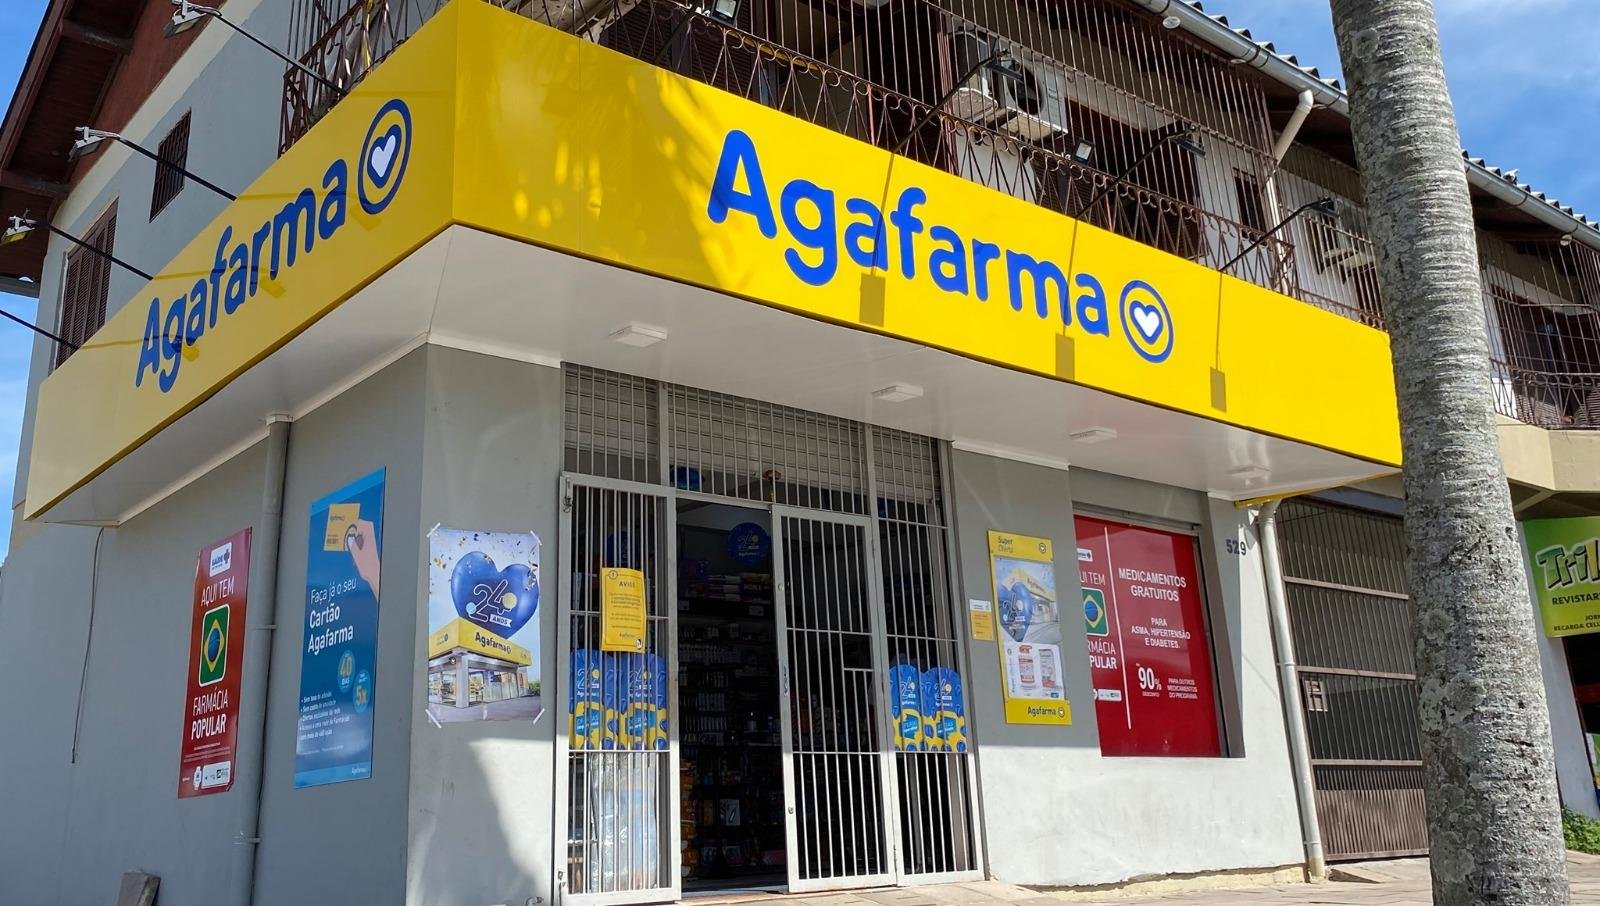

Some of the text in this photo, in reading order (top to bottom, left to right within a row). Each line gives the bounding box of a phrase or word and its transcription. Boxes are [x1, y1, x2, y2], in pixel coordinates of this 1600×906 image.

[707, 129, 1110, 337] Agafarma
[136, 159, 348, 393] Agafarma
[1226, 539, 1246, 556] 529
[1089, 572, 1106, 586] TEM
[1118, 567, 1187, 588] MEDICAMENTOS
[201, 576, 235, 607] AQUI TEM
[311, 578, 358, 605] Faça já o seu
[1130, 585, 1180, 602] GRATUITOS
[1552, 592, 1600, 606] REVISTAR
[466, 579, 515, 622] 24
[309, 603, 341, 629] Cartão
[492, 616, 509, 626] ANOS
[1151, 617, 1168, 627] PARA
[1131, 625, 1191, 640] ASMA, HIPERTENSÃO
[1553, 623, 1585, 631] RECARGA
[307, 625, 354, 656] Agafarma
[475, 631, 508, 653] Agafarma
[1087, 639, 1117, 655] RMÁCIA
[1145, 638, 1181, 649] E DIABETES.
[1090, 656, 1118, 670] PULAR
[192, 686, 229, 717] FARMÁCIA
[1028, 705, 1057, 718] Agafarma
[191, 713, 227, 741] POPULAR
